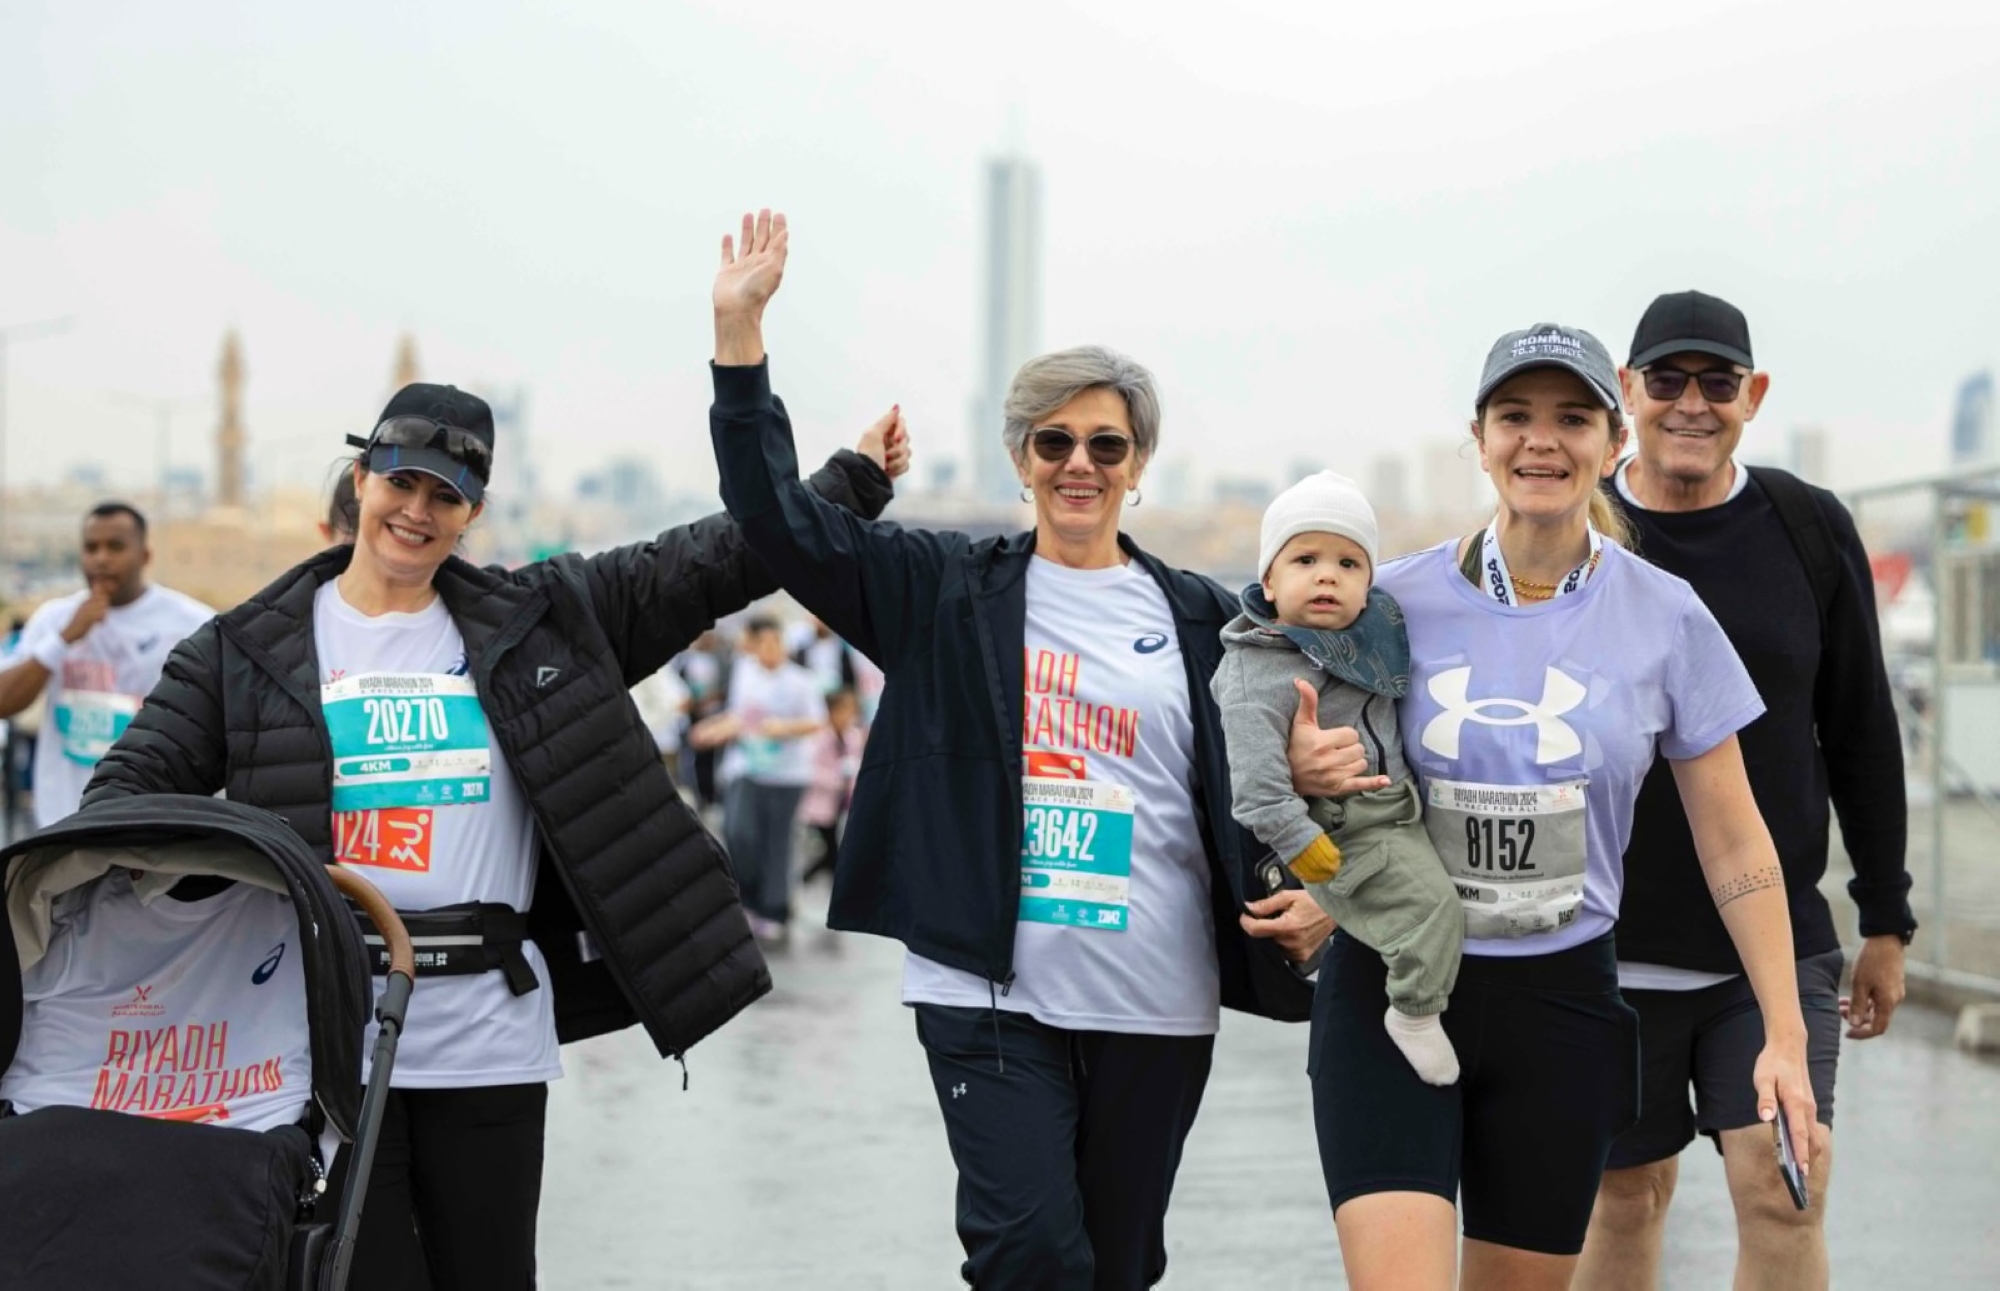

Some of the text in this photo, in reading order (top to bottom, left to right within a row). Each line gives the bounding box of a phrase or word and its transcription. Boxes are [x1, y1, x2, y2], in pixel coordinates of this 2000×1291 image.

[1513, 330, 1580, 349] IRONMAN
[1512, 344, 1536, 359] 70.3
[363, 698, 448, 744] 20270
[360, 760, 391, 773] 4KM
[1040, 783, 1077, 799] MARATHON
[1078, 786, 1093, 800] 2024
[1454, 788, 1478, 804] RIYADH
[1478, 789, 1519, 807] MARATHON
[1519, 791, 1538, 806] 2024
[1464, 803, 1488, 811] RACE
[1466, 816, 1536, 872] 8152
[103, 1020, 228, 1075] RIYADH
[90, 1056, 283, 1111] MARATHON
